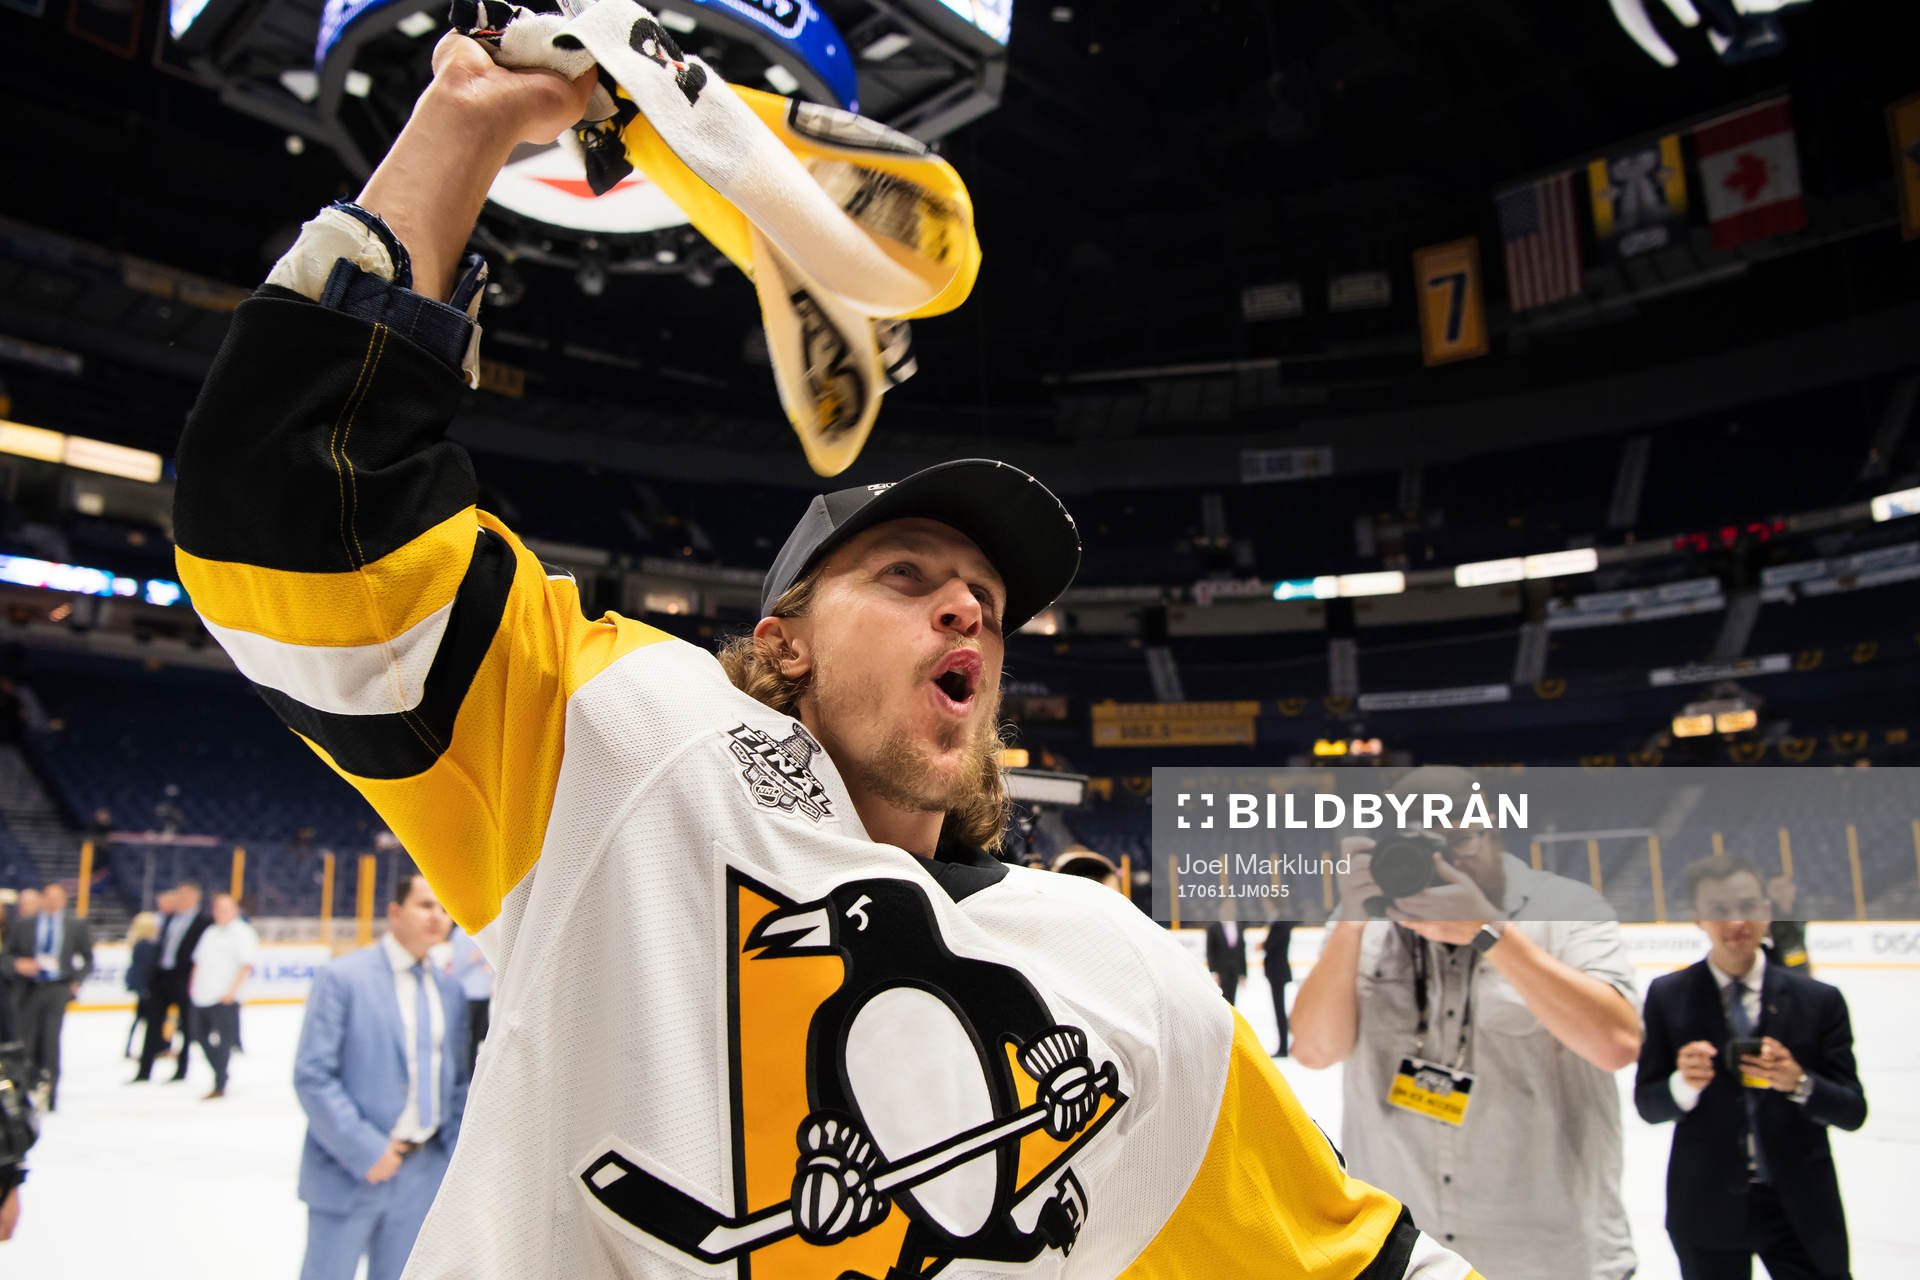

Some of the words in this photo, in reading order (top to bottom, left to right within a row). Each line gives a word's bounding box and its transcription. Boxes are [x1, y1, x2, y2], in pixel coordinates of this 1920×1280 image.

[1428, 272, 1467, 344] 7
[730, 723, 831, 814] FINAL
[755, 730, 803, 770] STANLEY
[801, 769, 824, 792] CUP
